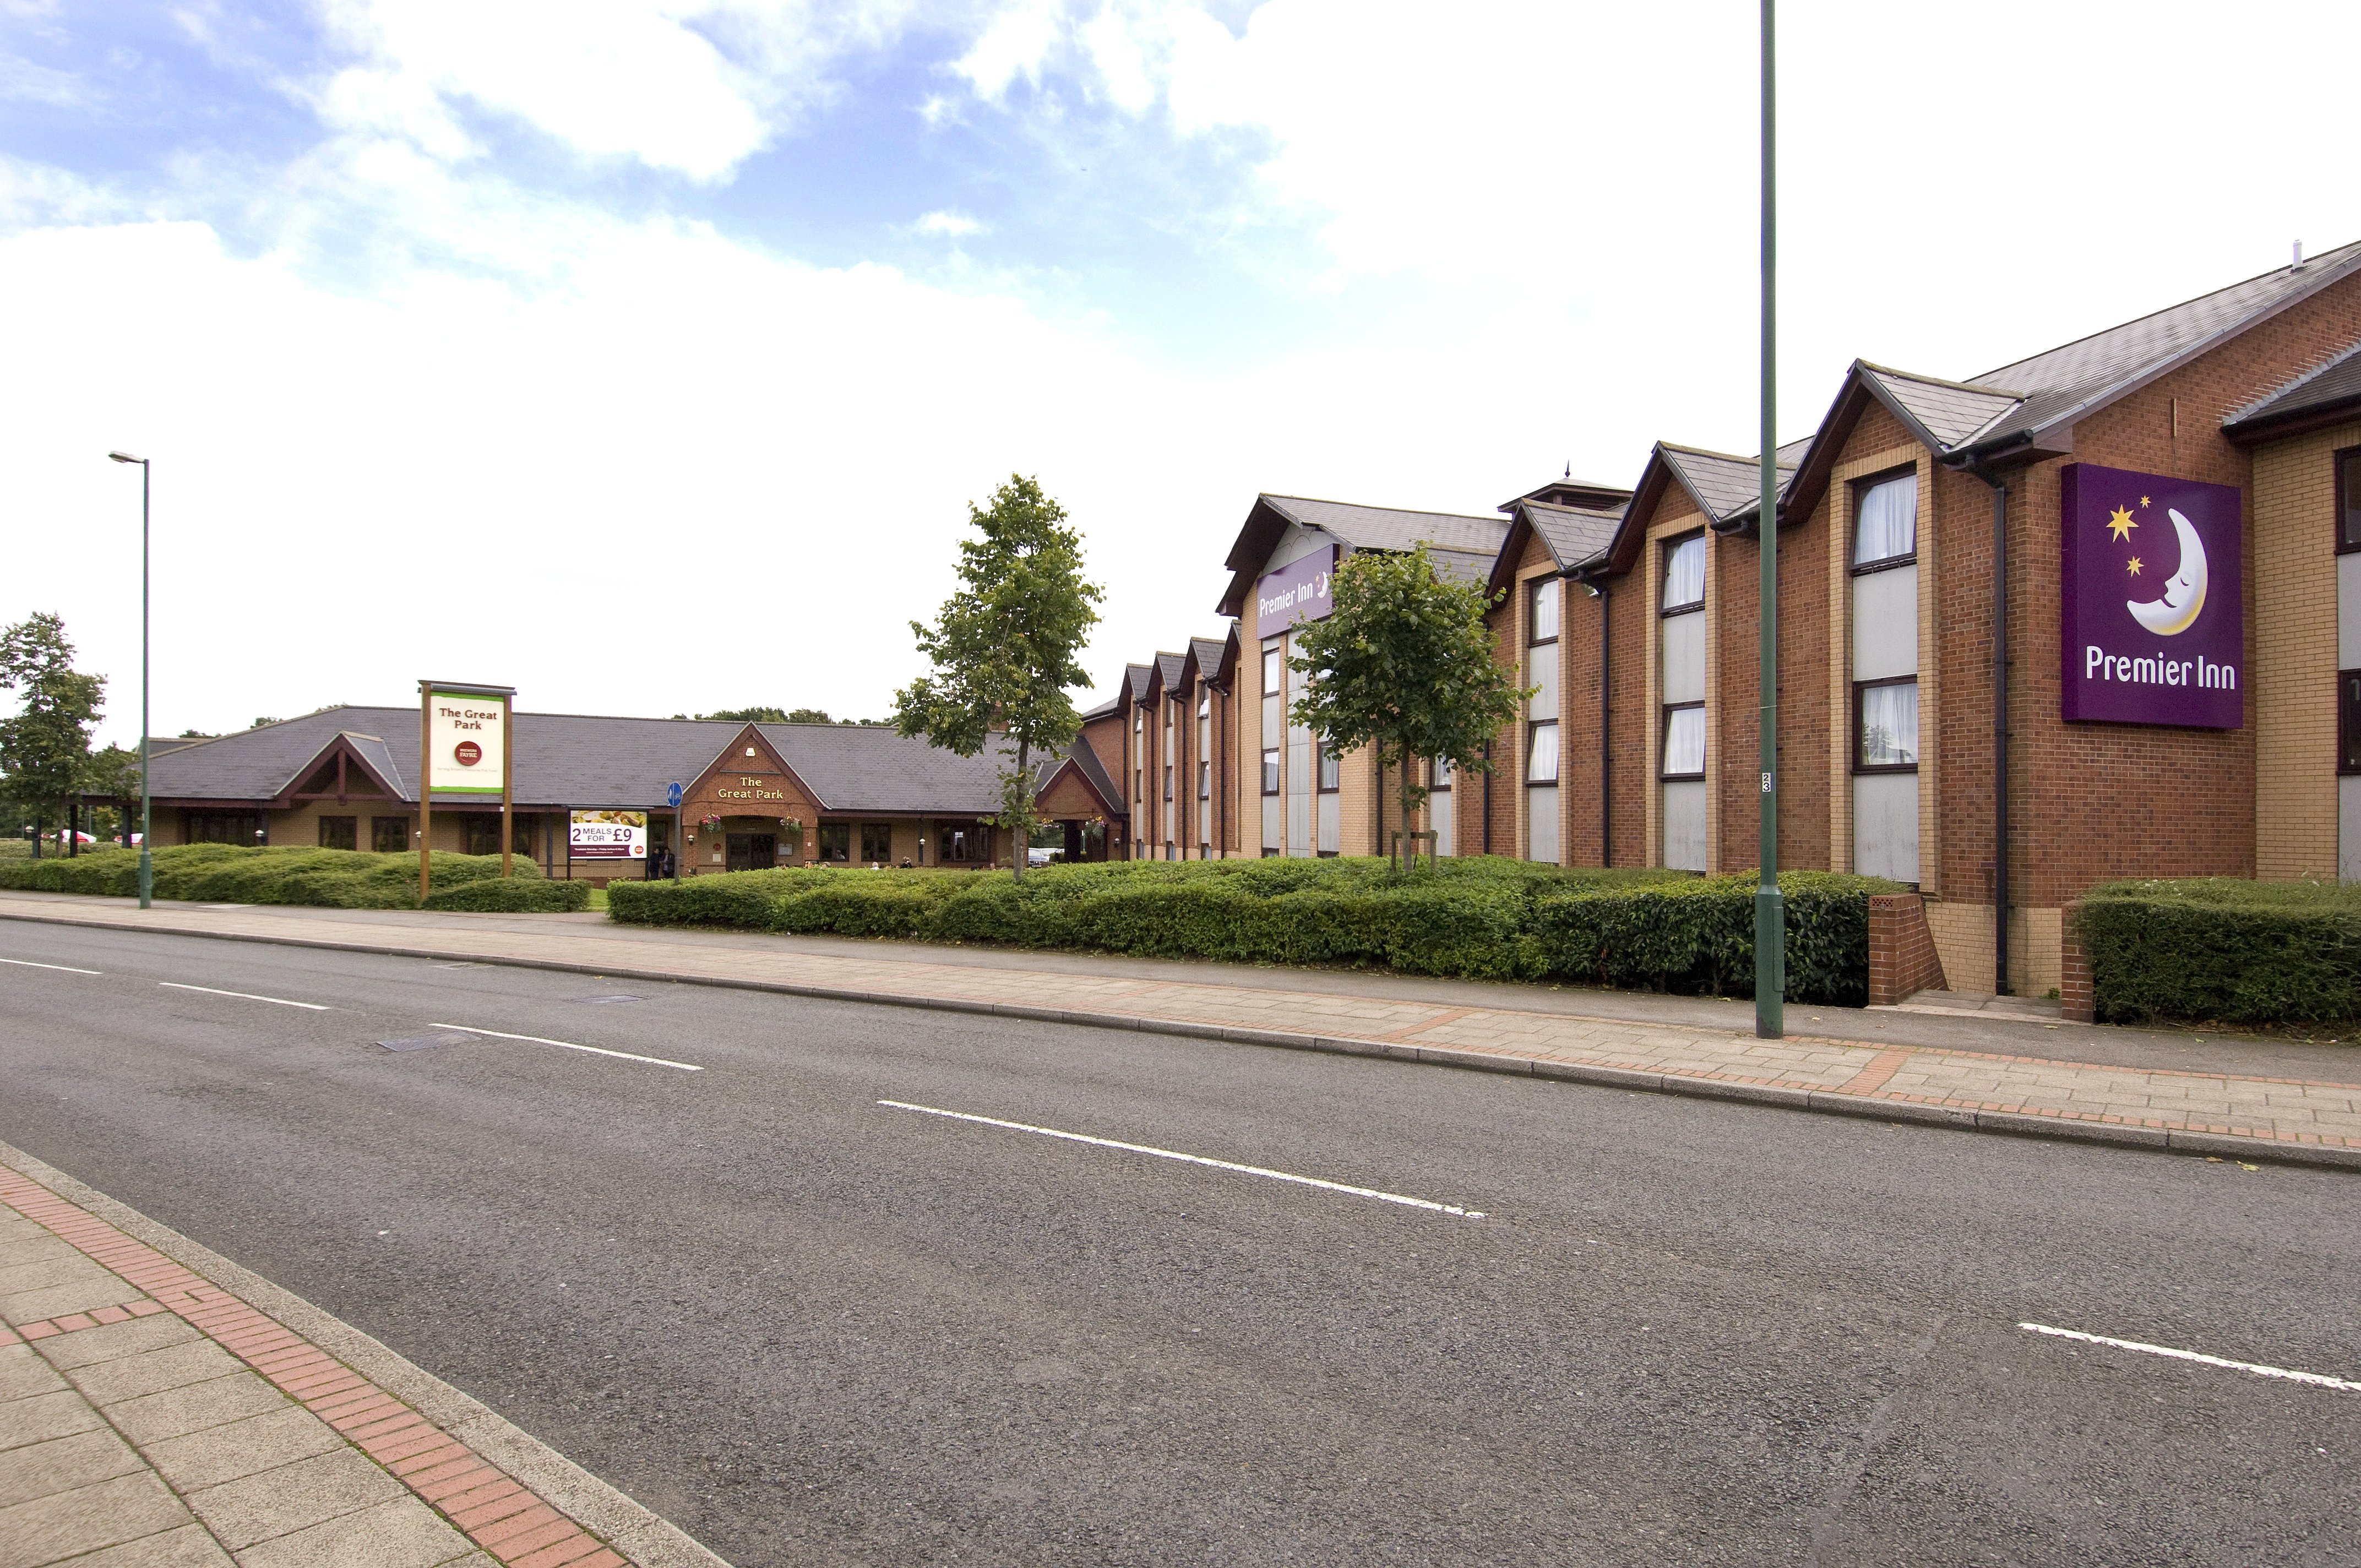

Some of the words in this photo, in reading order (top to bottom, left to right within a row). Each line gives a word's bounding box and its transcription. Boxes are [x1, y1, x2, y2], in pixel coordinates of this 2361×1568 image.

[1260, 589, 1296, 618] Premier
[1298, 582, 1313, 603] Inn
[2086, 645, 2193, 686] Premier
[2198, 655, 2235, 689] Inn
[439, 708, 461, 717] The
[465, 710, 497, 720] Great
[454, 720, 482, 729] Park
[740, 777, 762, 787] The
[718, 789, 752, 798] Great
[756, 790, 783, 799] Park
[573, 828, 581, 841] 2
